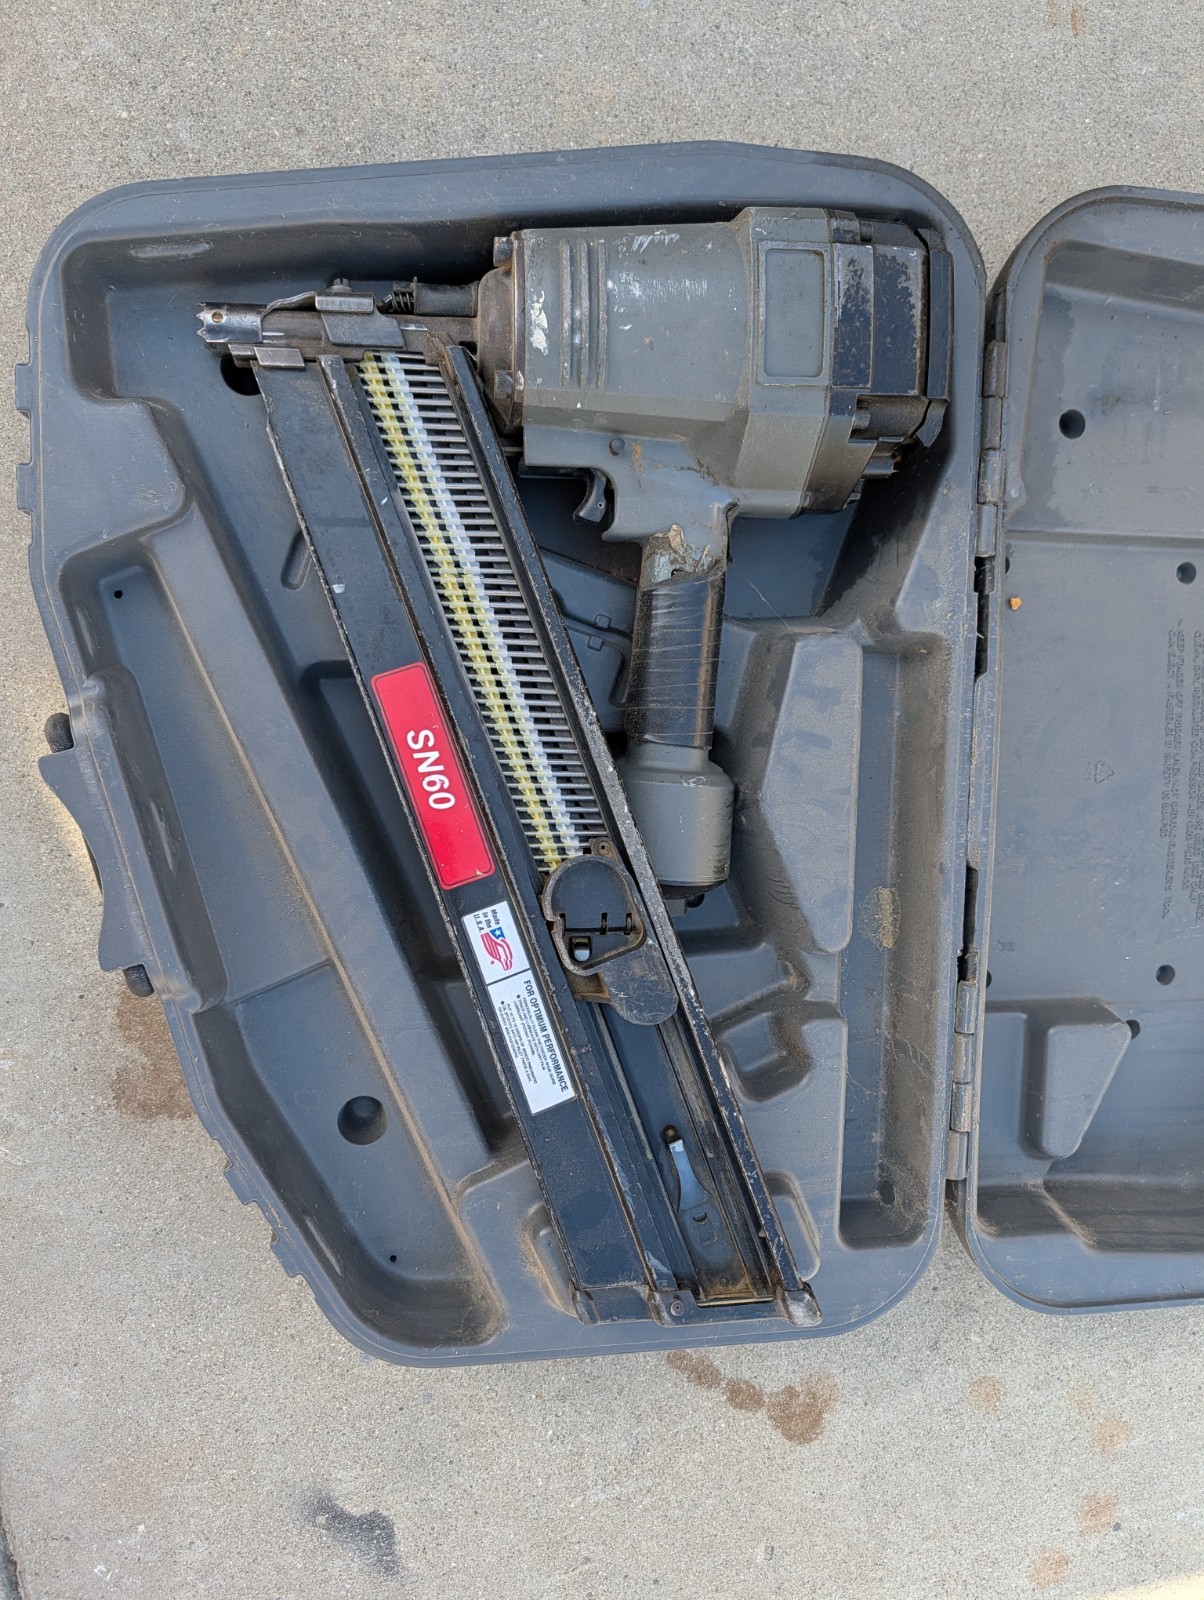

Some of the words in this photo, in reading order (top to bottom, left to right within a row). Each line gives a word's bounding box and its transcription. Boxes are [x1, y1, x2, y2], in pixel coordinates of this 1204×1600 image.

[406, 728, 456, 811] SN60
[484, 919, 492, 928] the
[490, 909, 500, 925] Made
[523, 979, 535, 997] FOR
[530, 997, 547, 1033] OPTIMUM
[542, 1033, 568, 1092] PERFORMANCE
